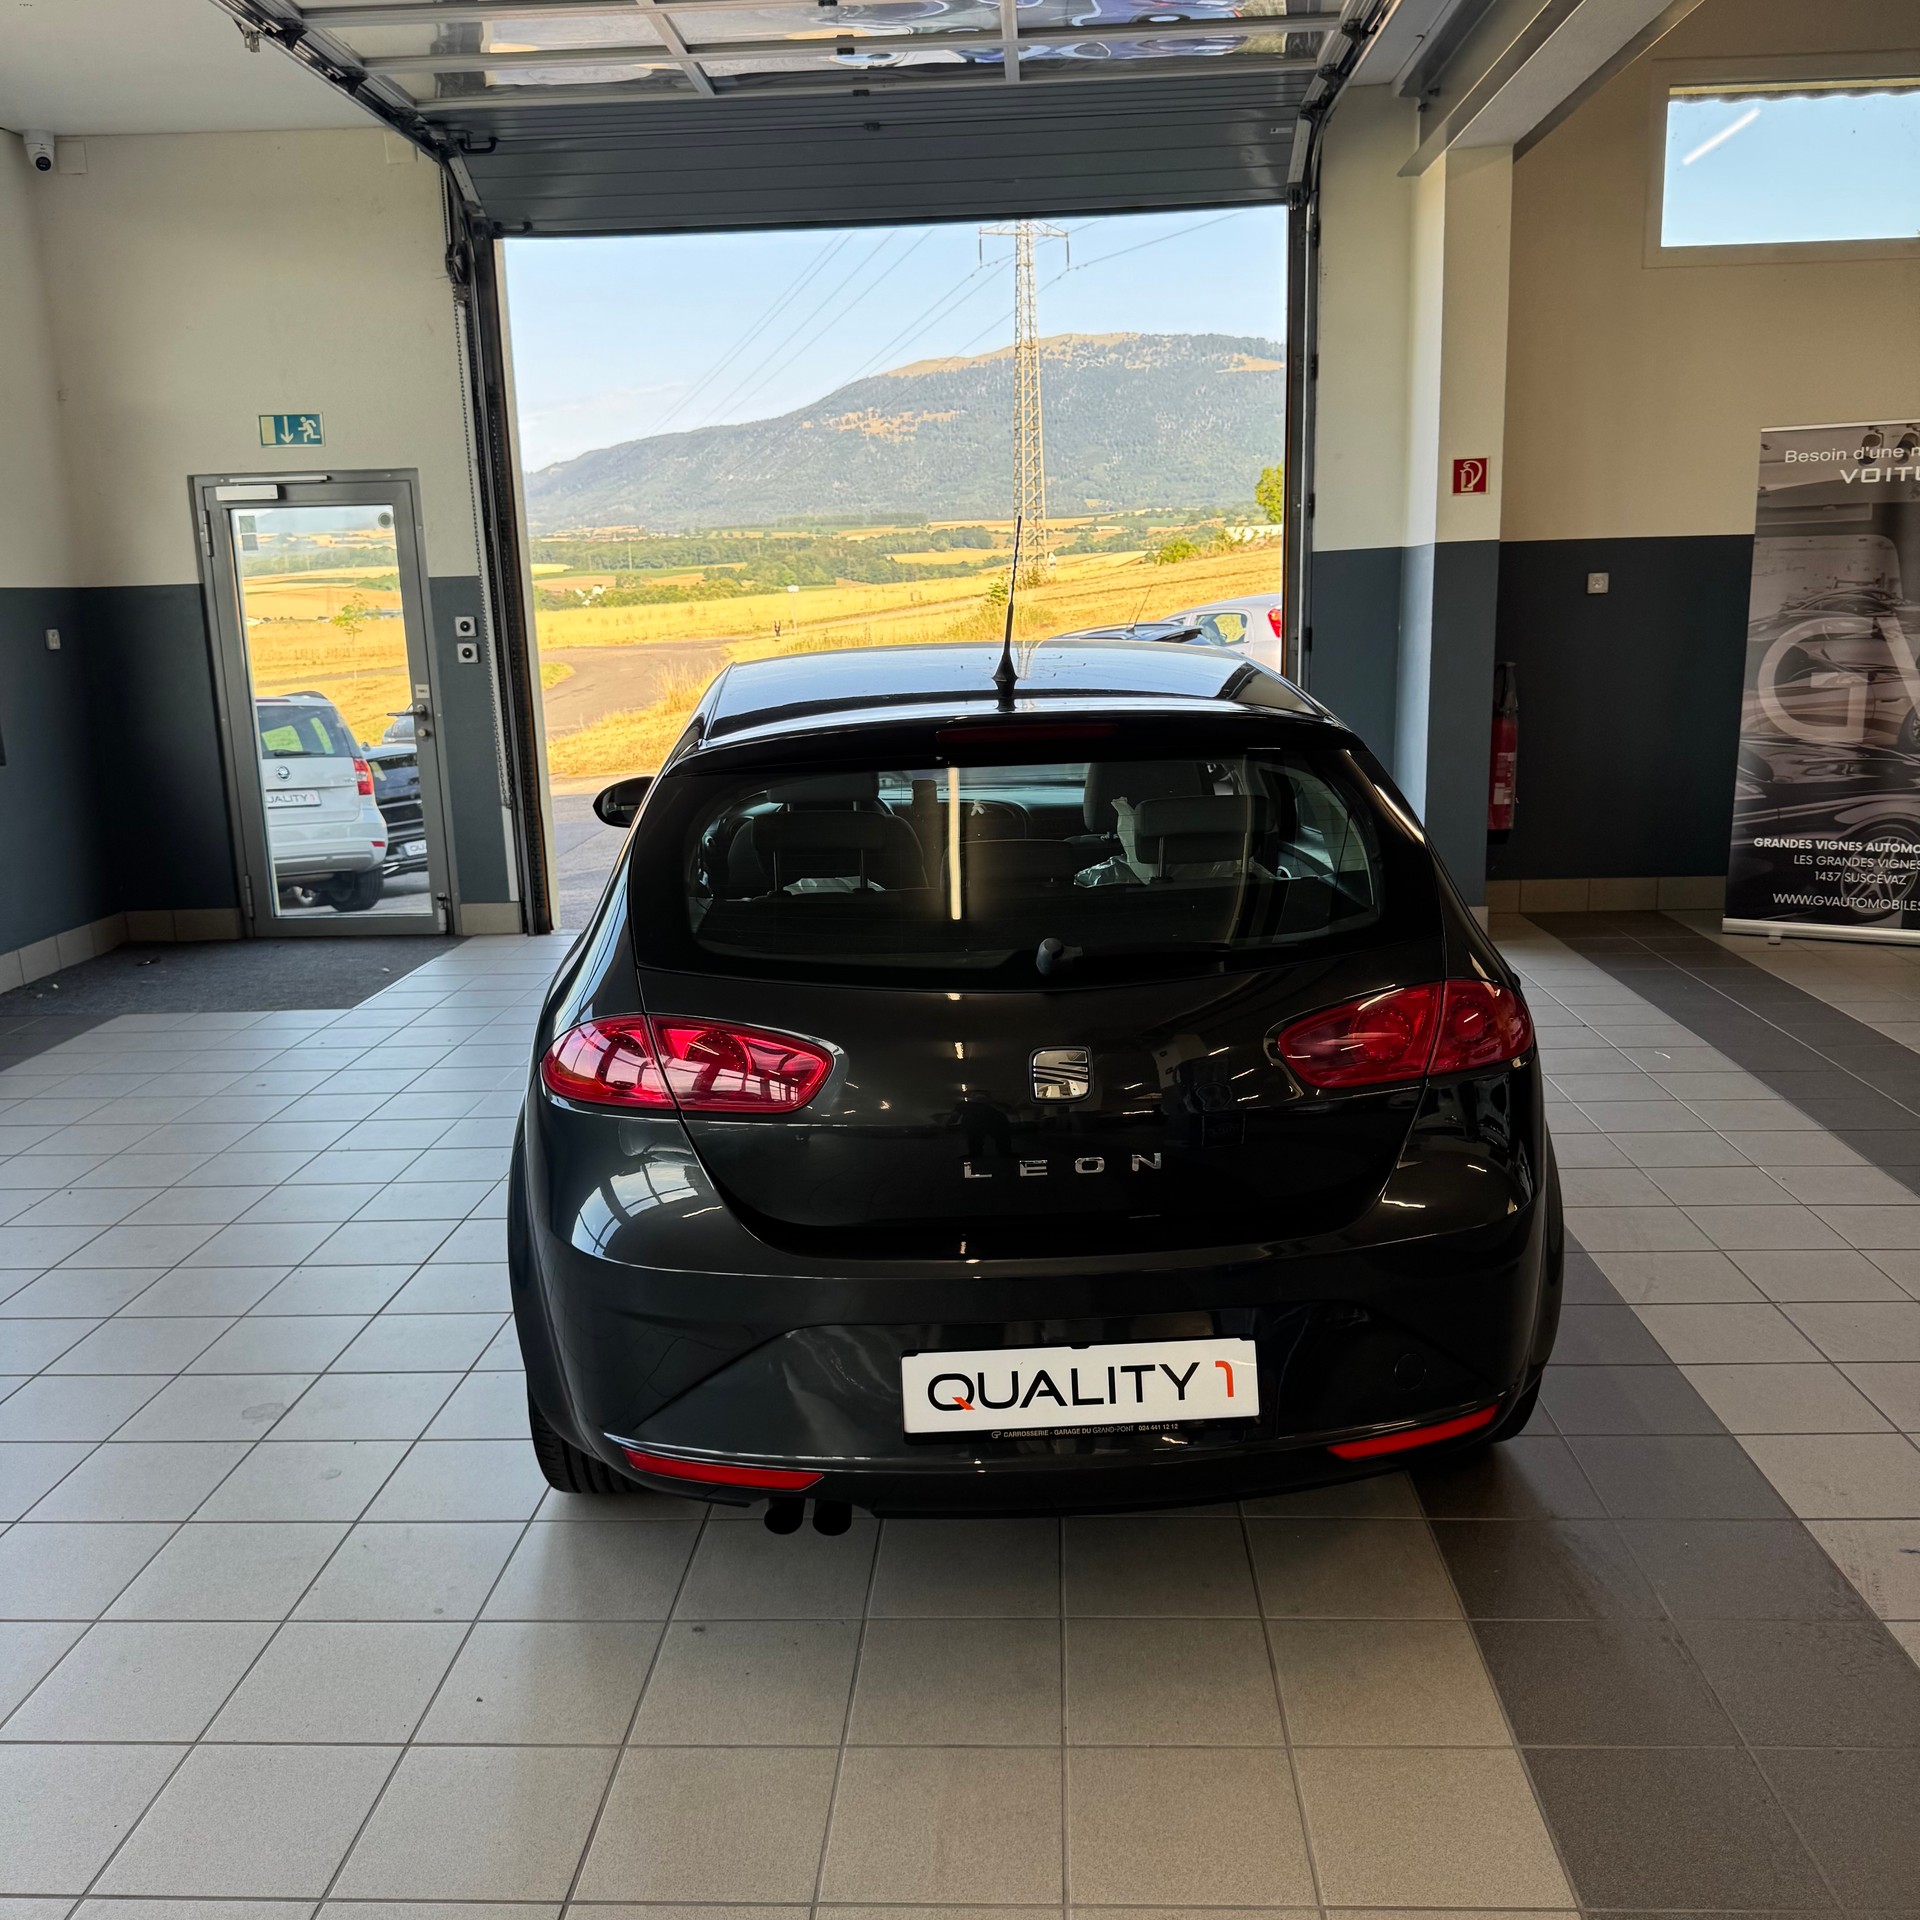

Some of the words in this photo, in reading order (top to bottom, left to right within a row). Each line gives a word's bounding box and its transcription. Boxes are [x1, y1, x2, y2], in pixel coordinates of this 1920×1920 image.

[1785, 448, 1847, 463] Besoin
[1853, 446, 1905, 460] d'une
[1839, 465, 1920, 484] VOIT
[1753, 837, 1813, 850] GRANDES
[1815, 840, 1863, 852] VIGNES
[1793, 854, 1813, 866] LES
[1816, 855, 1874, 868] GRANDES
[1814, 870, 1842, 882] 1437
[1844, 871, 1907, 885] SUSCÉVAZ
[963, 1152, 1162, 1178] LEON
[927, 1361, 1201, 1411] QUALITY
[1214, 1360, 1235, 1398] 1
[1003, 1429, 1049, 1438] CARROSSERIE
[1054, 1427, 1081, 1436] GARAGE
